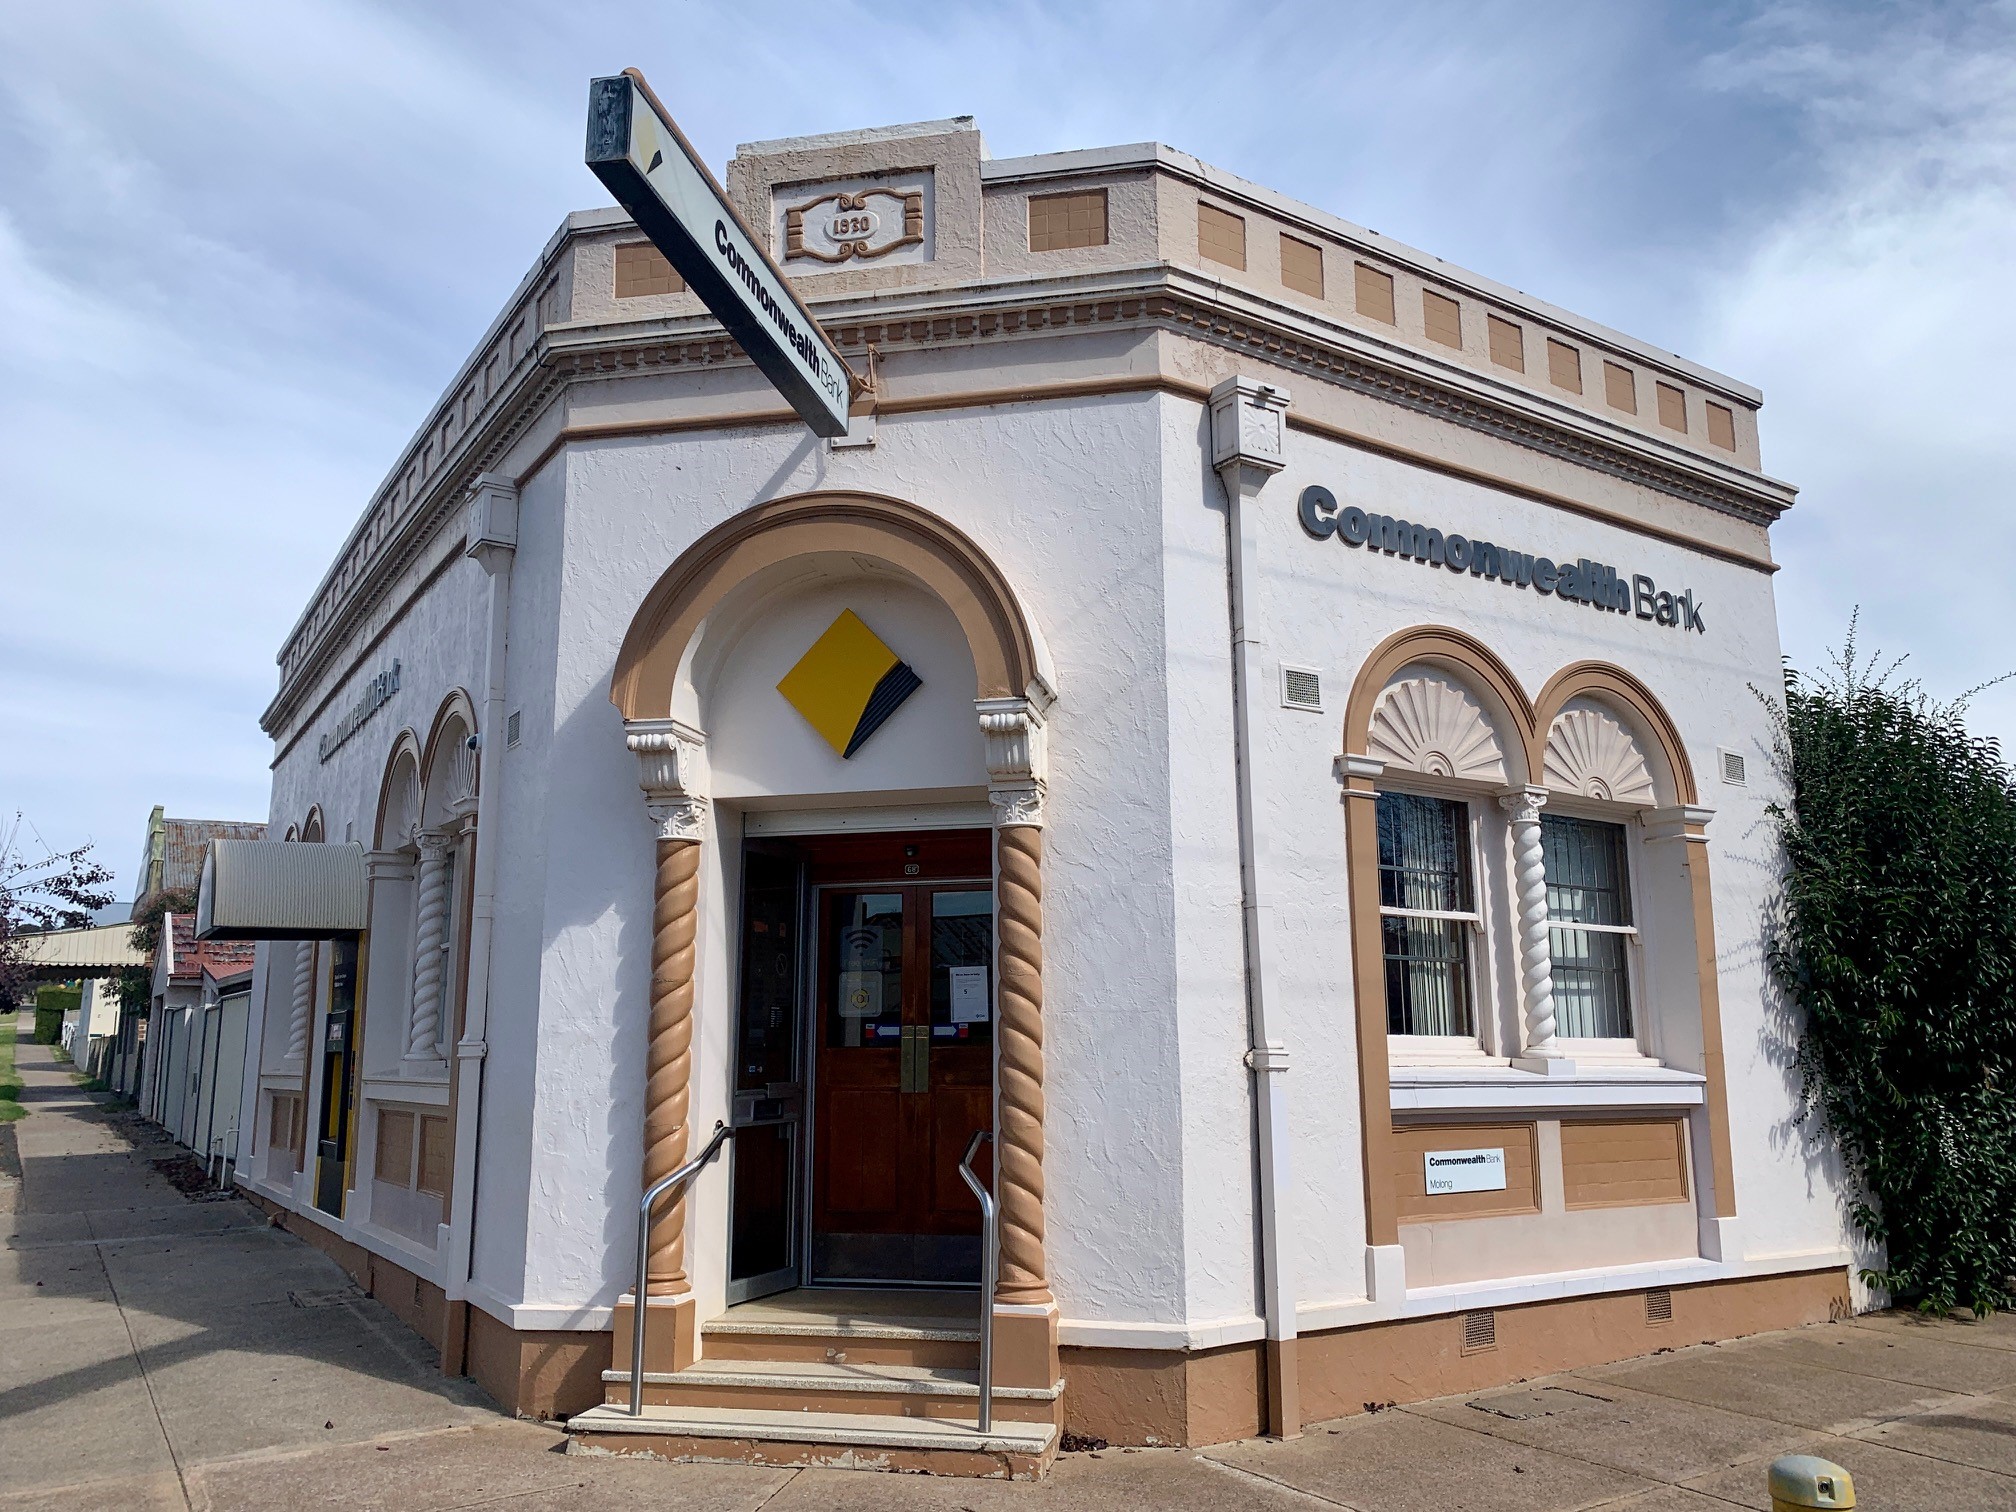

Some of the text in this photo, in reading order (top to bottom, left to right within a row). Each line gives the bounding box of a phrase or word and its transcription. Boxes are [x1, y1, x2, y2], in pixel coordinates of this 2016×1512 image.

[834, 216, 870, 234] 1930
[714, 219, 845, 410] Commonwealth Bank
[1297, 484, 1706, 635] Commonwealth Bank
[1429, 1154, 1501, 1167] Commonwealth Bank
[1430, 1179, 1453, 1190] Molong
